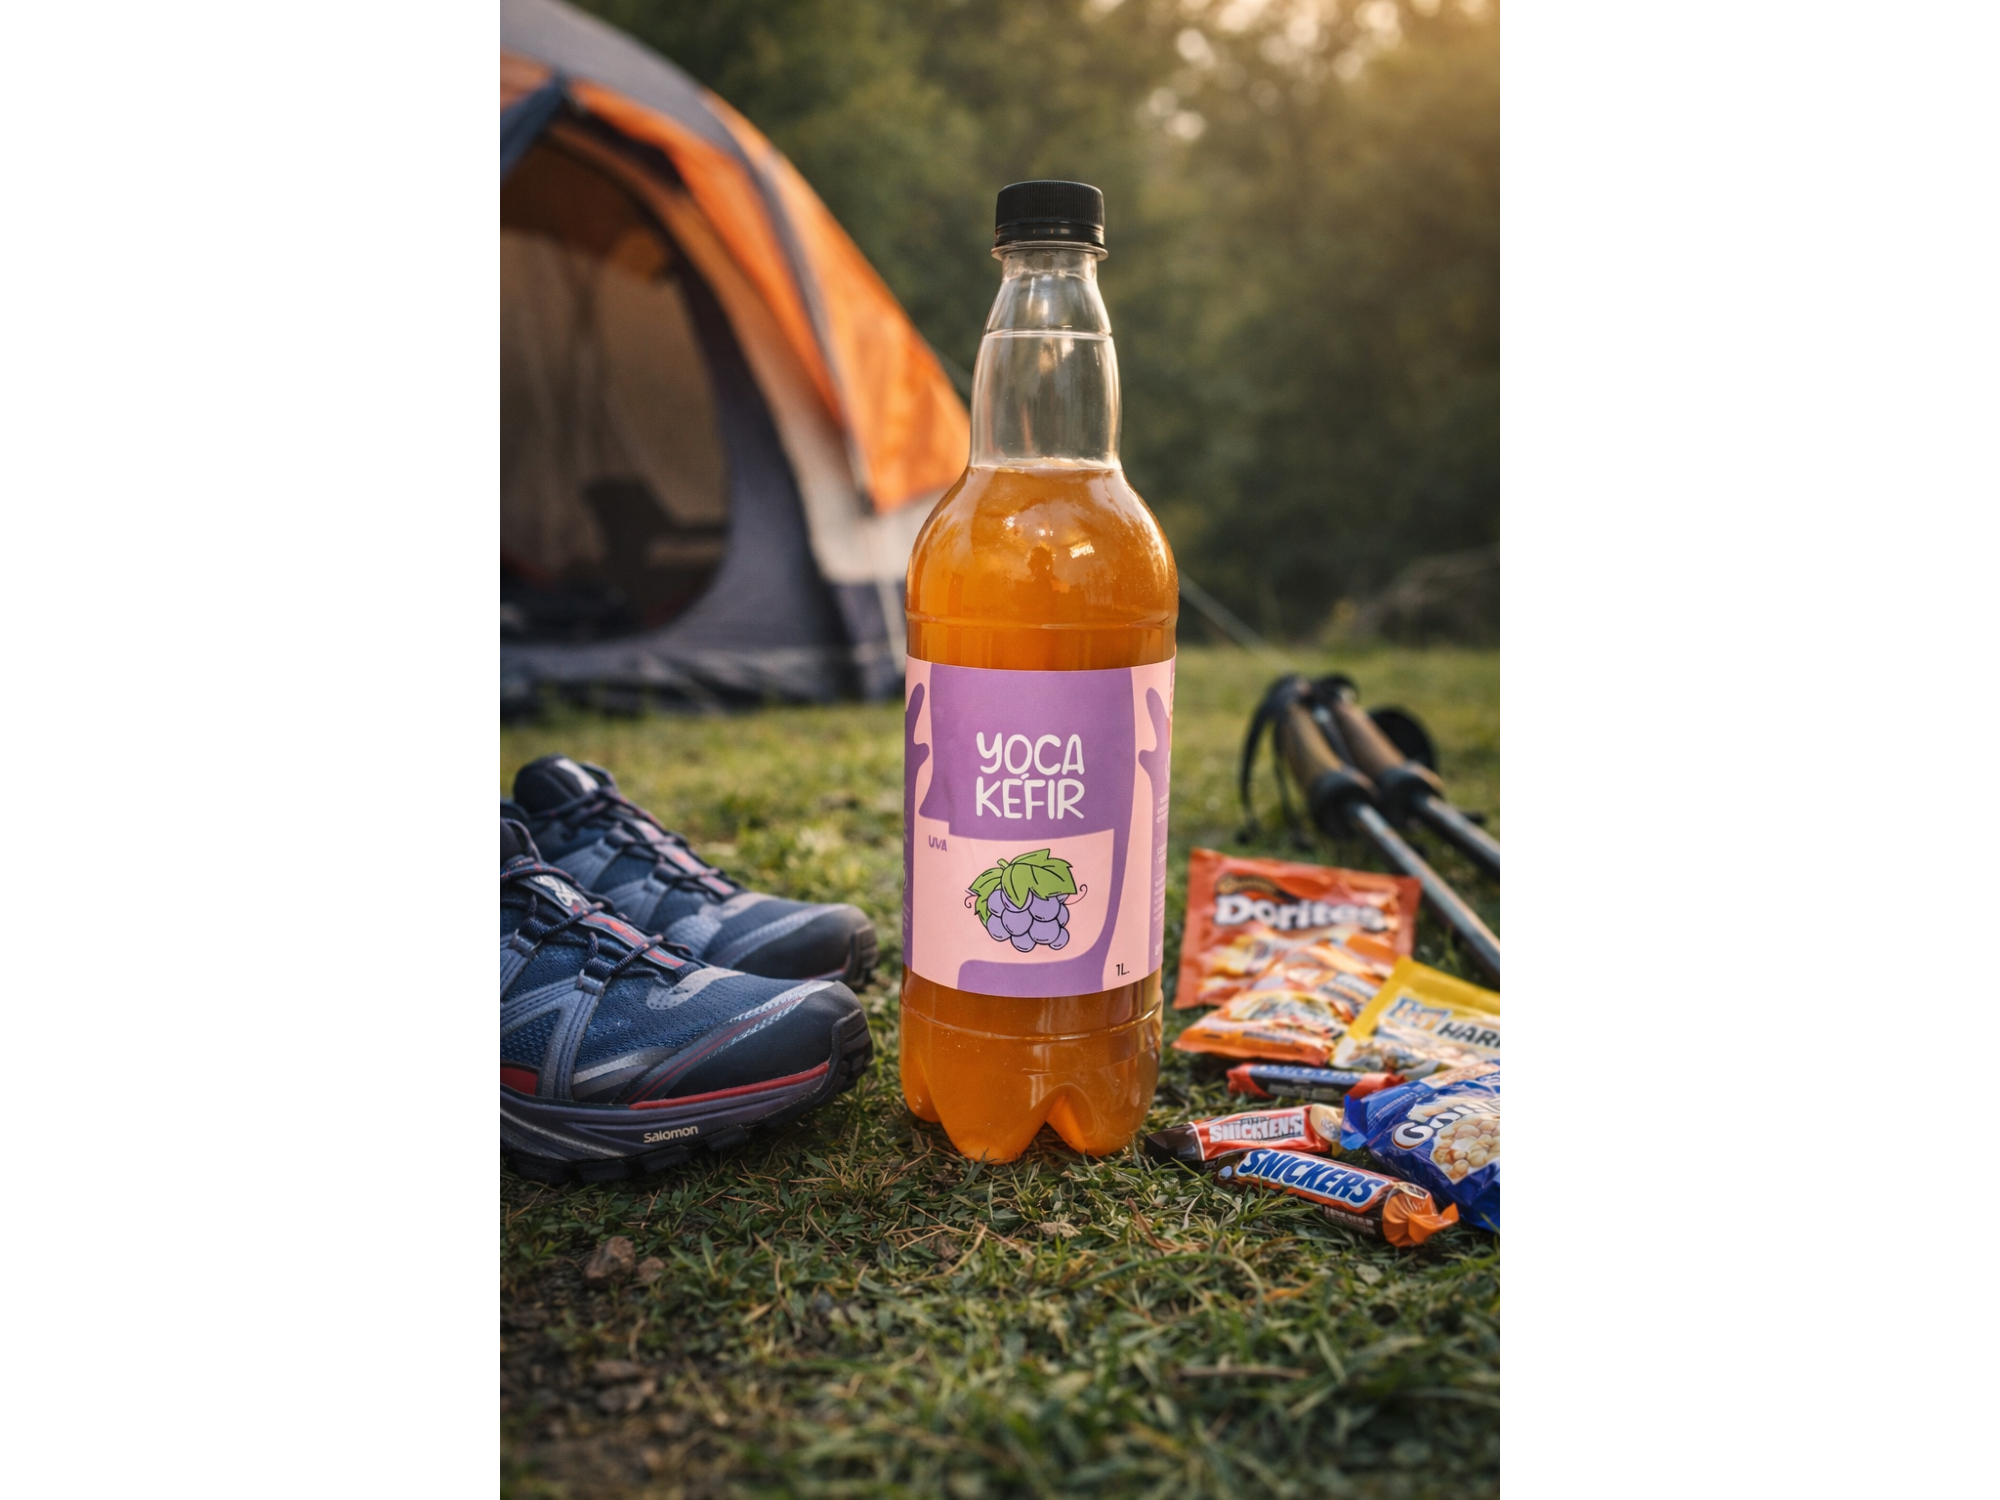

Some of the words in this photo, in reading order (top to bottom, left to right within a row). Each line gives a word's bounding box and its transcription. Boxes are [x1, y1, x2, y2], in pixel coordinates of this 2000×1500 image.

[976, 731, 1085, 775] YOCA
[975, 773, 1085, 820] KÉFIR
[928, 835, 947, 852] UVA
[1437, 1022, 1500, 1049] HAR
[643, 1125, 699, 1143] Salomon
[1238, 1149, 1385, 1204] SNICKERS
